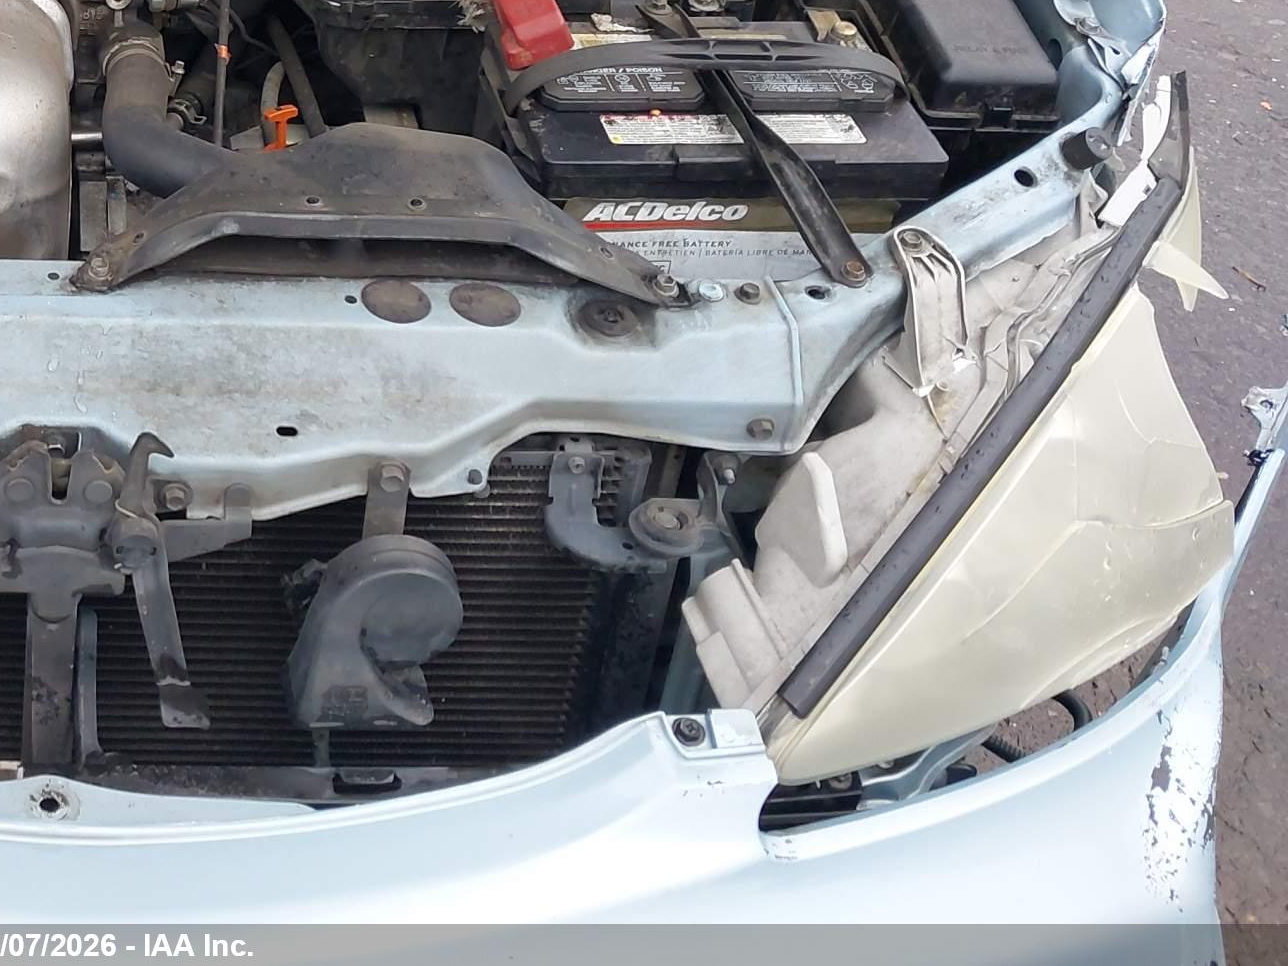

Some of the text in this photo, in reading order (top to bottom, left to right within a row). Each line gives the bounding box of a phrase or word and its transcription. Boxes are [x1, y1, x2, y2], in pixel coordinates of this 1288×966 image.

[582, 201, 749, 222] ACDelco
[651, 240, 680, 248] FREE
[682, 239, 731, 248] BATTERY
[643, 249, 696, 257] ENTRETIEN
[747, 249, 773, 257] LIBRE
